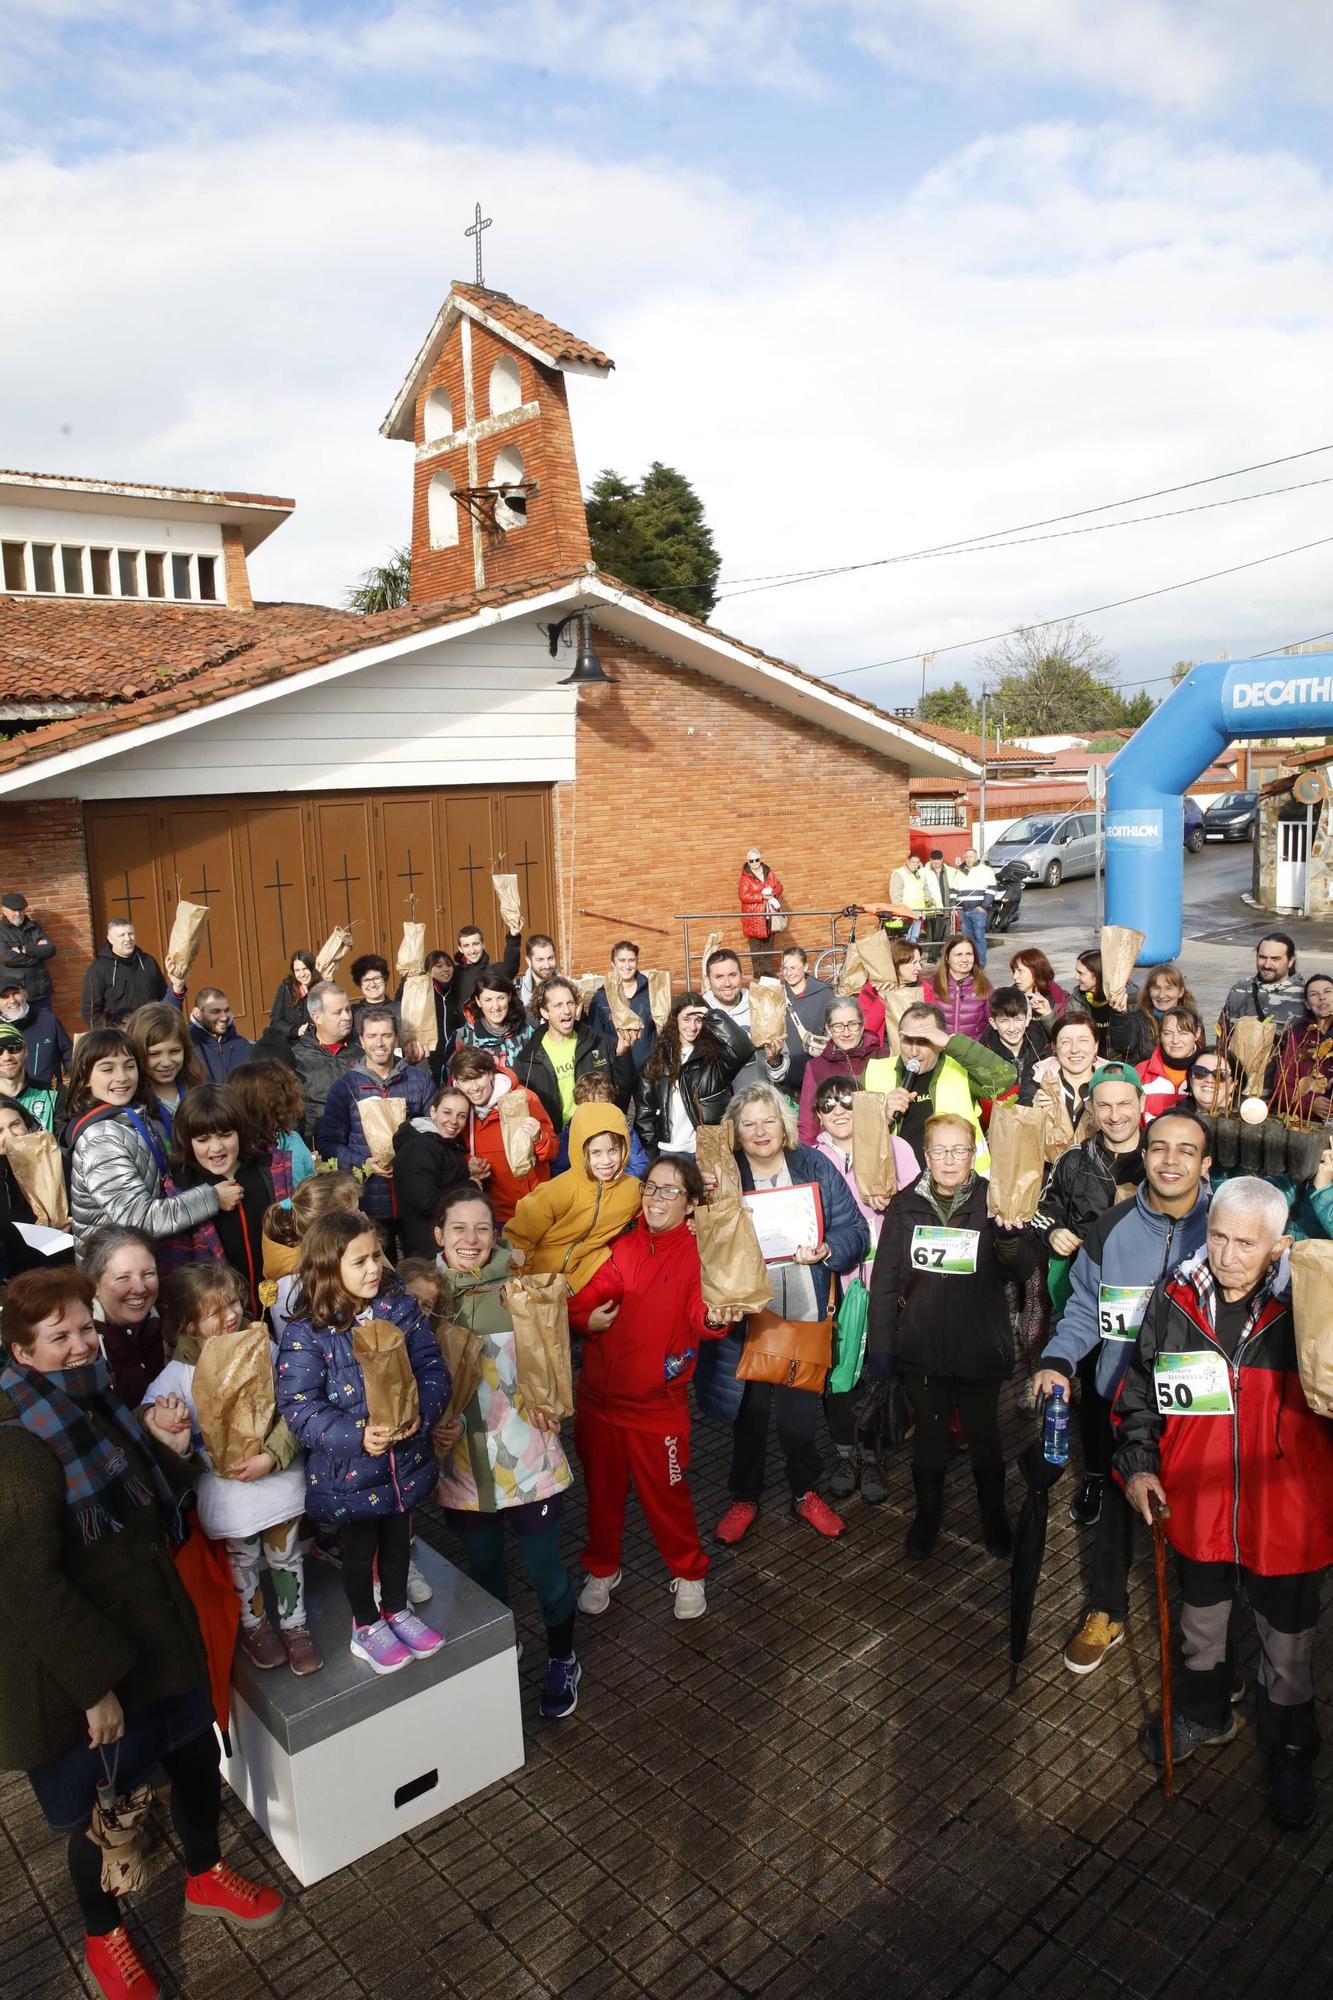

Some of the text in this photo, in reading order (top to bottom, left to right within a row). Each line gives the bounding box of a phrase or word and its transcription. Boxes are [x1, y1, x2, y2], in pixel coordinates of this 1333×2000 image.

[1233, 677, 1333, 708] DECATH
[913, 1246, 946, 1268] 67
[1101, 1311, 1128, 1336] 51
[1157, 1382, 1193, 1409] 50
